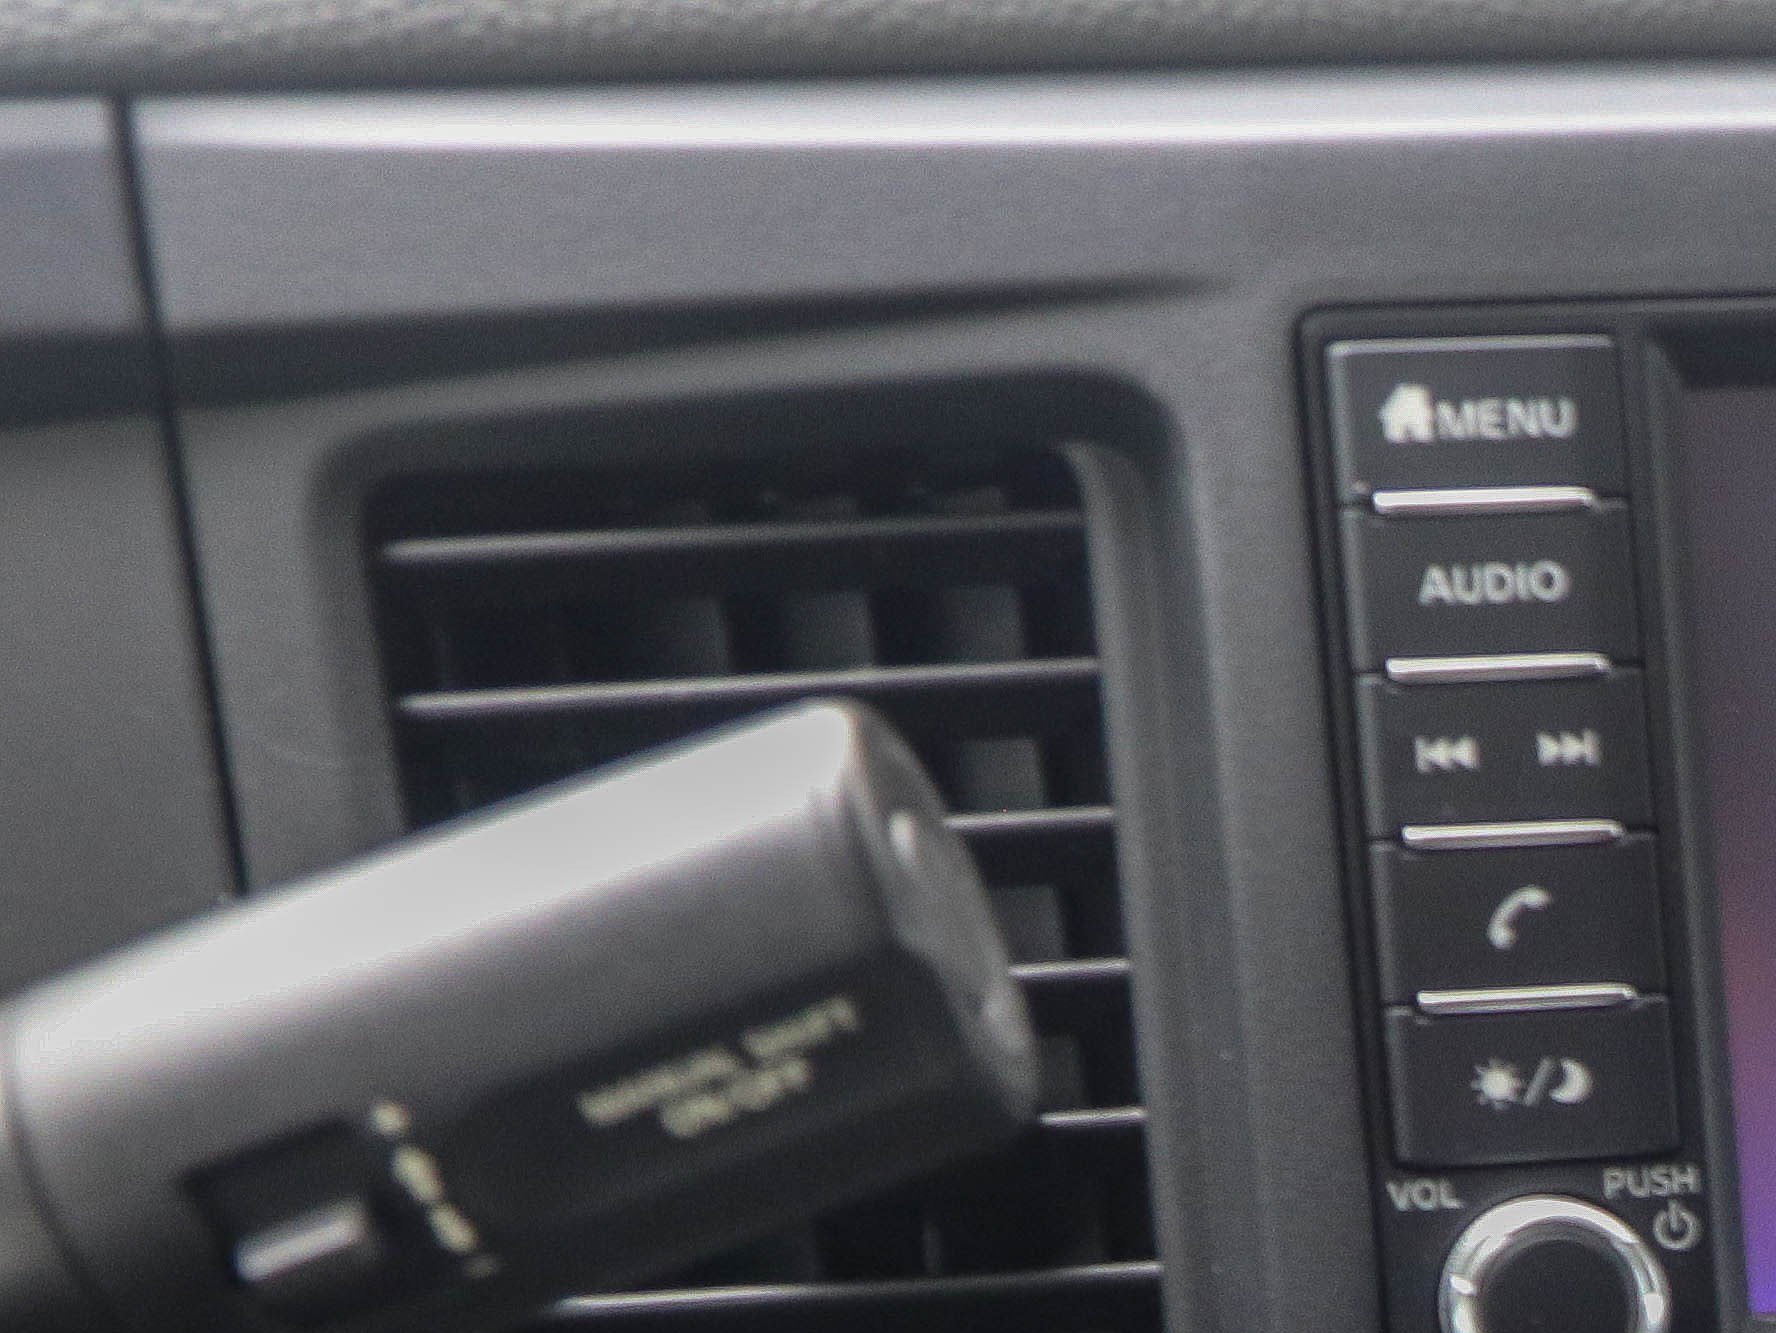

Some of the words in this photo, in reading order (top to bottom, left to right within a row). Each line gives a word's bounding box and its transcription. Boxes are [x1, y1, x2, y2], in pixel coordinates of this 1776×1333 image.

[1435, 398, 1577, 441] MENU
[1419, 560, 1570, 604] AUDIO
[1387, 1178, 1464, 1213] VOL
[1602, 1166, 1701, 1199] PUSH
